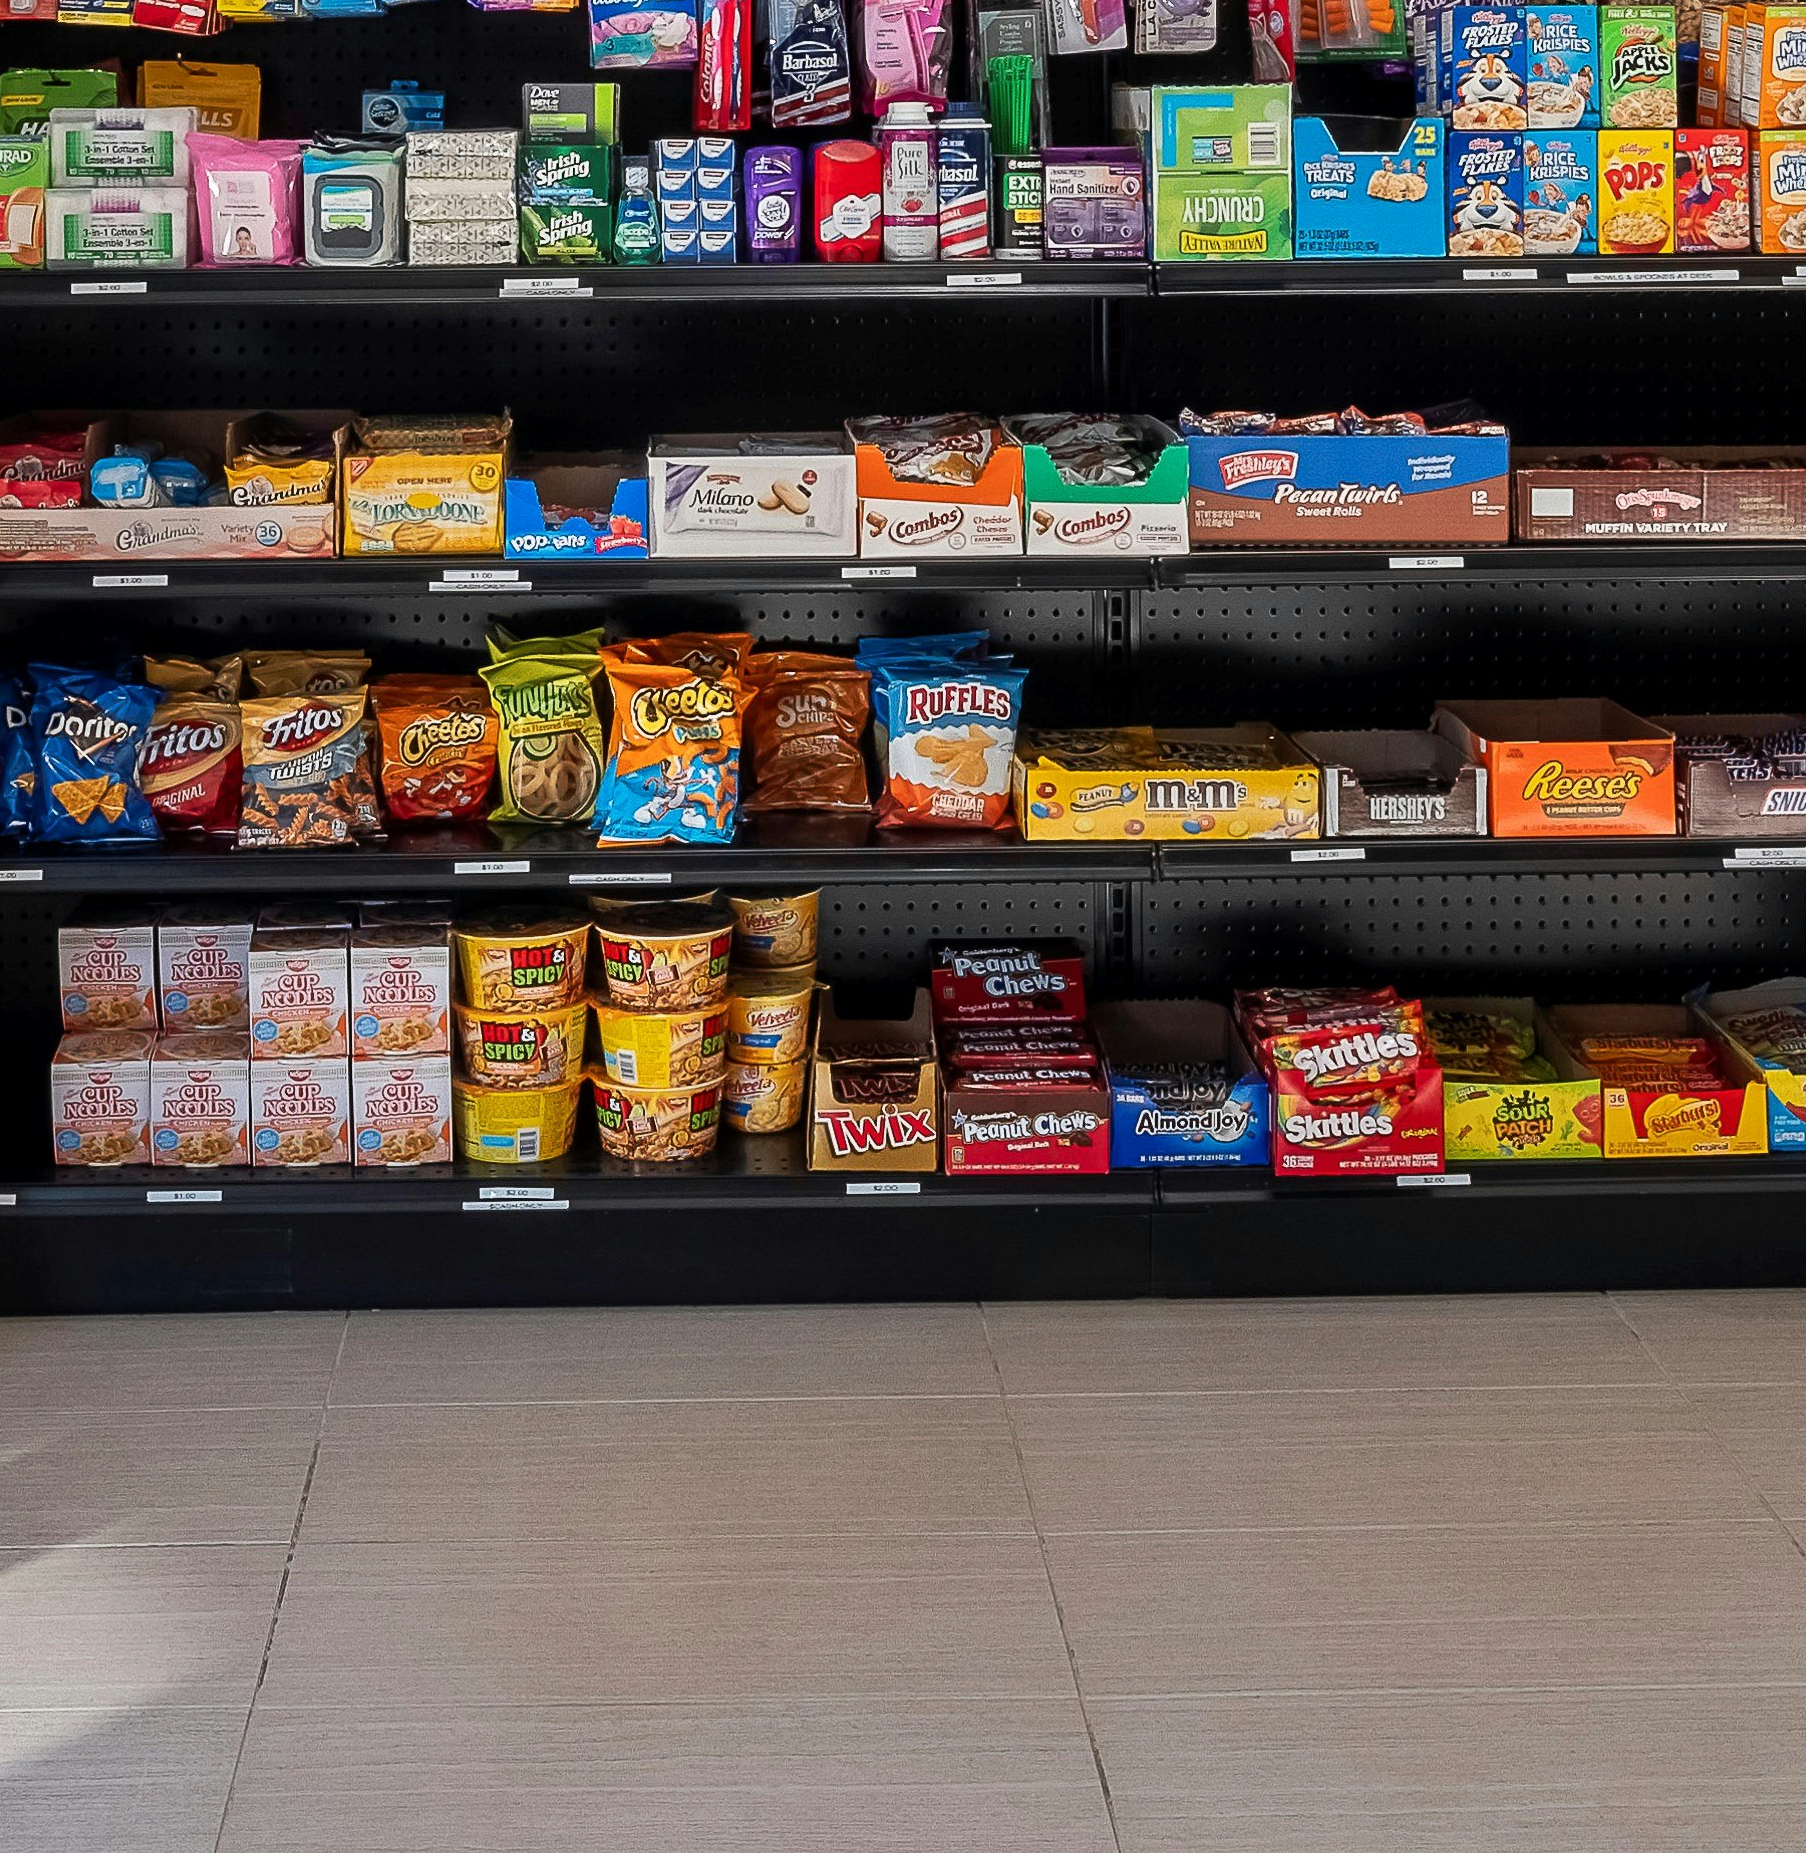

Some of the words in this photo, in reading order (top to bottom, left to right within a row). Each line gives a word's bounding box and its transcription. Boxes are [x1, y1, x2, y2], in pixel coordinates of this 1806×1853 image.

[1462, 22, 1518, 39] FROSTED
[1542, 25, 1577, 39] RICE
[1465, 34, 1513, 49] FLAKES
[1534, 39, 1590, 53] KRISPIES
[1622, 46, 1658, 56] APPLE
[701, 33, 714, 103] Colgate
[783, 53, 838, 71] Barbasol
[1611, 53, 1671, 90] JACKS
[1414, 126, 1436, 144] 25
[112, 144, 141, 154] Cotton
[143, 144, 155, 154] Set
[545, 151, 581, 172] Irish
[1539, 152, 1576, 166] RICE
[536, 159, 590, 187] Spring
[897, 160, 924, 180] Silk
[1305, 170, 1355, 184] TREATS
[1531, 167, 1588, 181] KRISPIES
[1050, 184, 1073, 195] Hand
[1077, 184, 1119, 194] Sanitizer
[1604, 162, 1665, 201] POPS
[1182, 195, 1265, 223] CRUNCHY
[110, 228, 140, 238] Cotton
[141, 228, 154, 238] Set
[754, 230, 784, 241] power
[477, 466, 495, 478] 30
[397, 477, 424, 486] OPEN
[426, 477, 452, 486] HERE
[690, 489, 754, 507] Milano
[1274, 485, 1339, 504] Pecan
[1339, 483, 1400, 504] Twirls
[712, 507, 749, 515] chocolate
[974, 515, 1012, 524] Cheddar
[1296, 506, 1332, 517] Sweet
[1333, 506, 1362, 517] Rolls
[258, 526, 278, 539] 36
[895, 512, 958, 540] Combos
[1585, 522, 1634, 534] MUFFIN
[1636, 522, 1692, 533] VARIETY
[1692, 522, 1728, 533] TRAY
[230, 534, 248, 543] Mix
[494, 681, 591, 721] FUNYUNS
[777, 693, 835, 727] Sun
[909, 683, 1011, 725] RUFFLES
[139, 724, 226, 765] Fritos
[398, 712, 486, 766] Cheetos
[1522, 761, 1643, 801] Reese's
[1078, 789, 1114, 804] PEANUT
[1144, 779, 1248, 810] m&m's
[1370, 796, 1445, 822] HERSHEY'S
[87, 950, 126, 967] CUP
[186, 949, 227, 966] CUP
[512, 950, 552, 968] HOT
[953, 954, 1040, 978] Peanut
[71, 966, 141, 983] NOODLES
[172, 963, 242, 981] NOODLES
[380, 972, 421, 988] CUP
[513, 968, 564, 986] SPICY
[278, 973, 319, 991] CUP
[985, 974, 1066, 997] Chews
[261, 989, 334, 1008] NOODLES
[363, 986, 436, 1005] NOODLES
[1294, 1033, 1418, 1082] Skittles
[1496, 1103, 1550, 1121] SOUR
[1648, 1100, 1719, 1133] Starburst
[816, 1104, 936, 1156] Twix
[1496, 1119, 1552, 1136] PATCH
